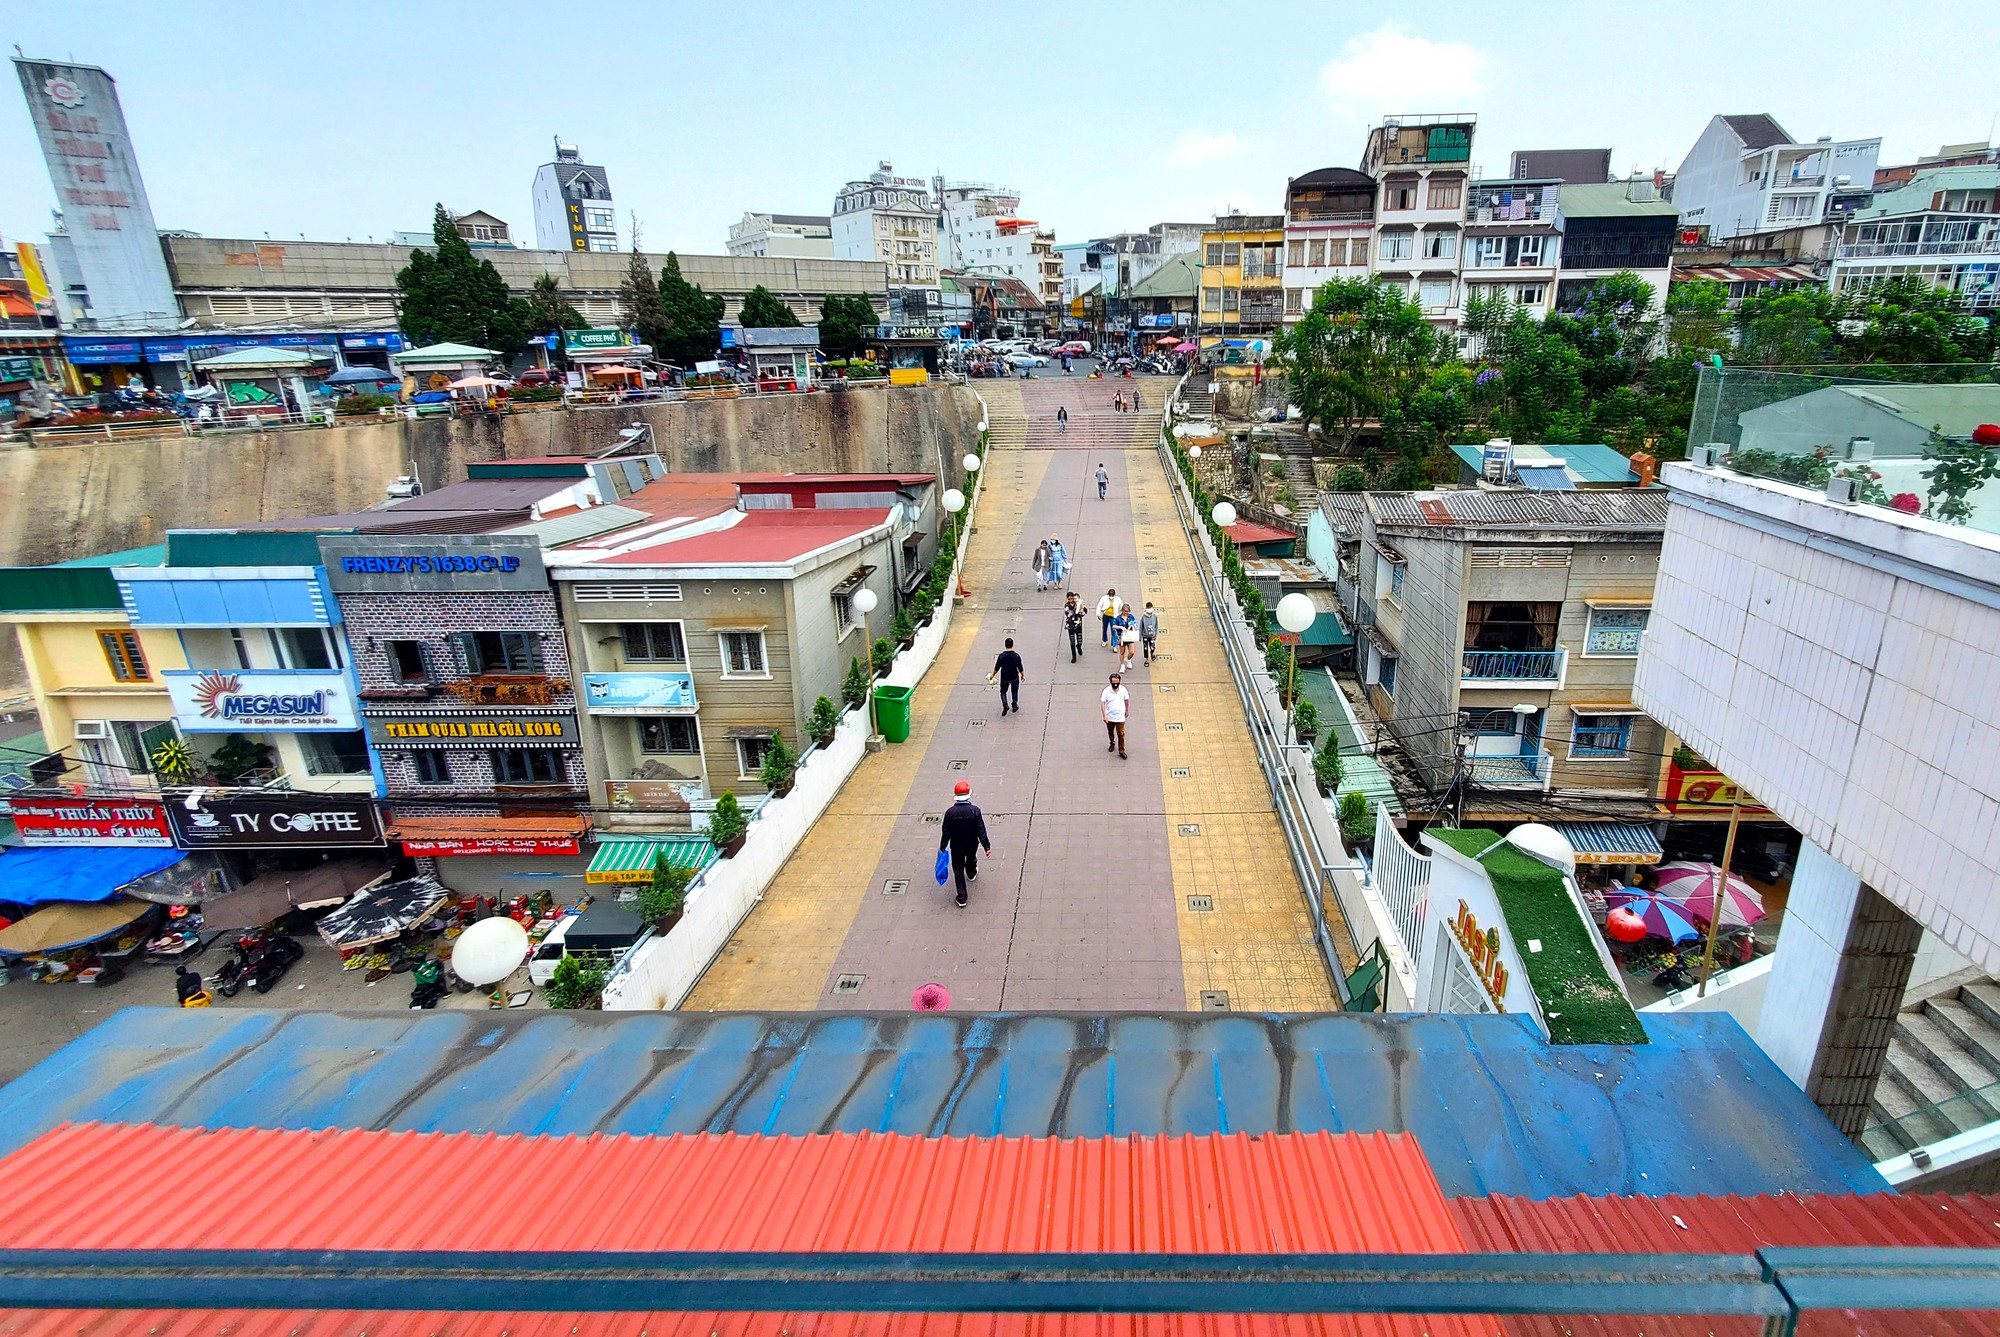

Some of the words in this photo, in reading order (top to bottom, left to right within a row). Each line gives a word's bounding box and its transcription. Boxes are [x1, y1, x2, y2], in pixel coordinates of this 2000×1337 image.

[570, 205, 583, 232] KIM
[581, 334, 603, 343] COFFEE
[341, 556, 431, 573] FRENZY'S
[431, 555, 476, 572] 1638
[223, 690, 325, 719] MEGASUN
[385, 723, 430, 737] THAM
[430, 722, 468, 738] QUAN
[469, 720, 498, 737] NHÀ
[498, 720, 524, 737] CỦA
[524, 722, 563, 736] KONG
[231, 813, 260, 832] TY
[55, 827, 80, 837] BAO
[82, 828, 100, 837] DA
[512, 839, 537, 847] CHO
